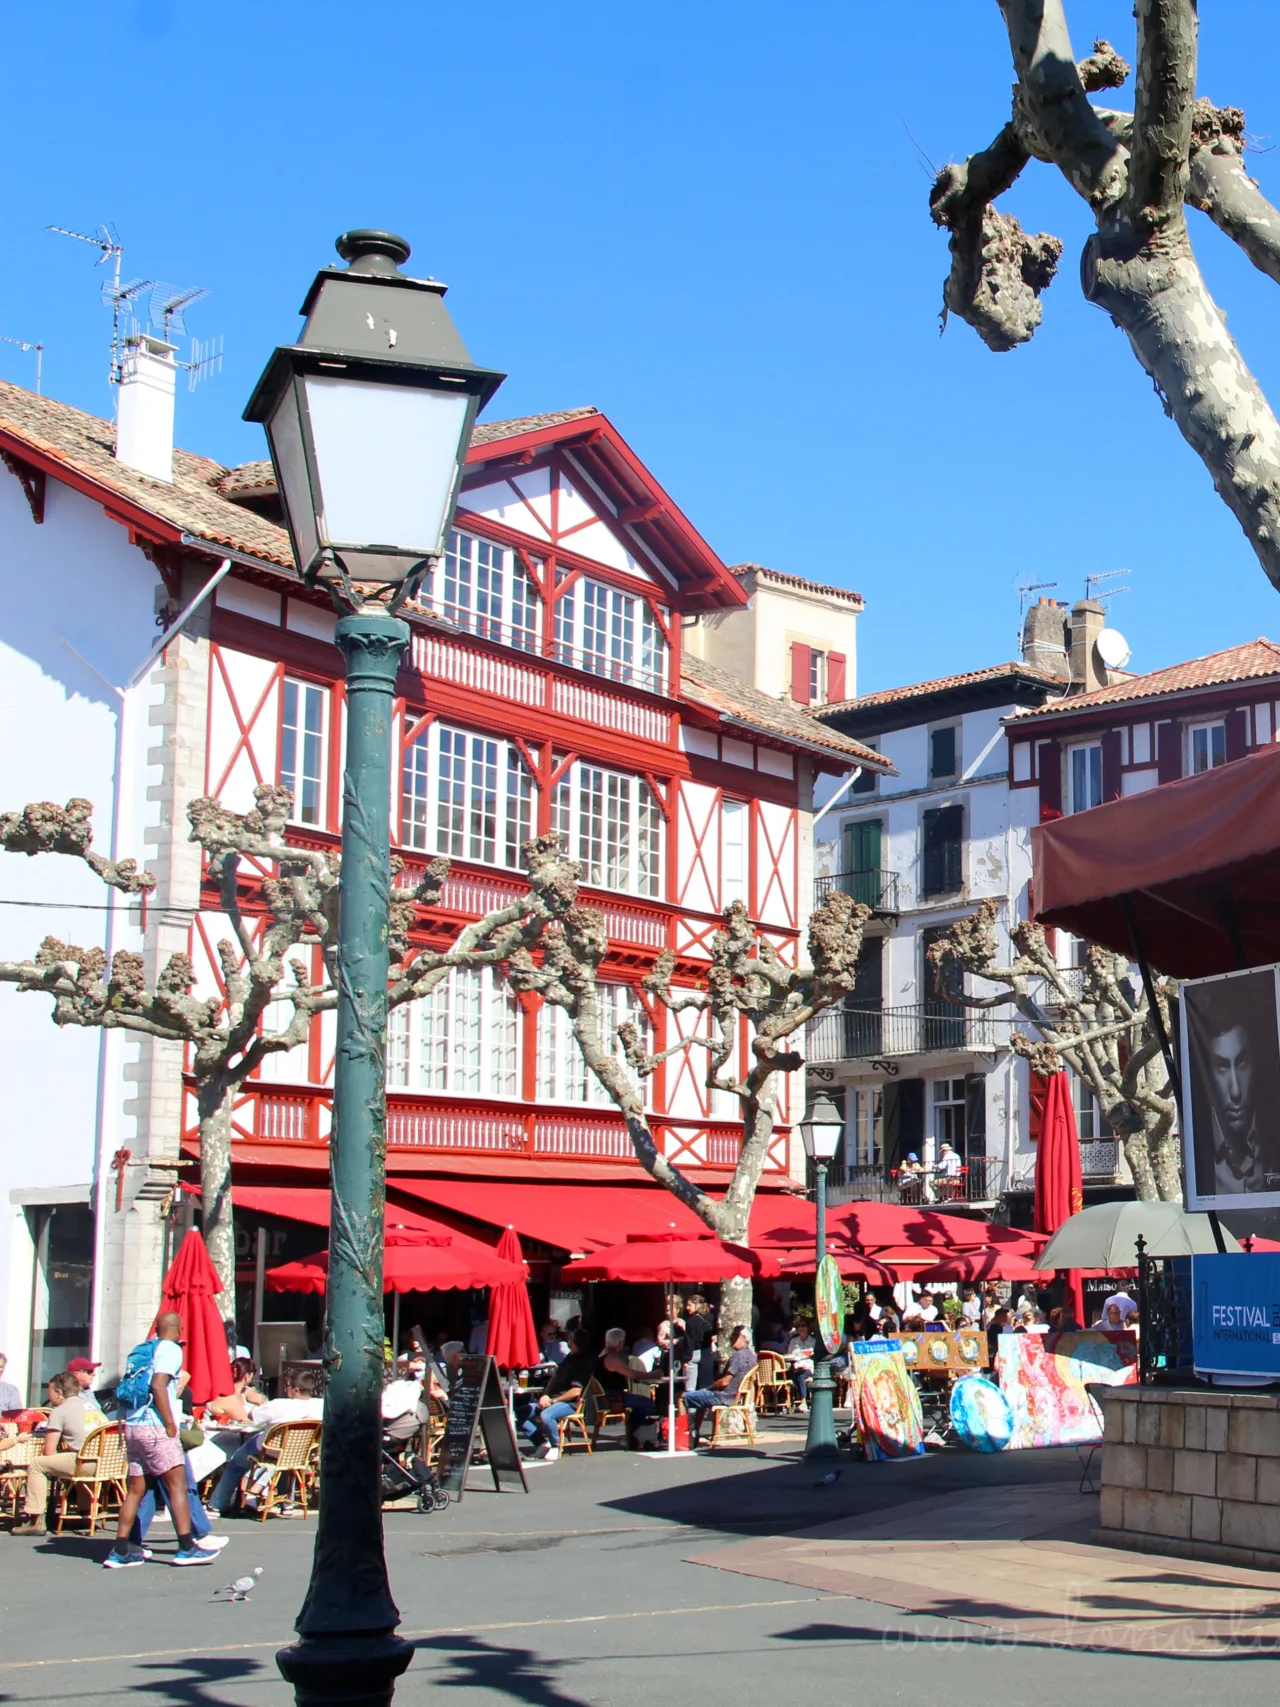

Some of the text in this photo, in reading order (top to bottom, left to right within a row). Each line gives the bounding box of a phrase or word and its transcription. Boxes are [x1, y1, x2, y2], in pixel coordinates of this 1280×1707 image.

[1086, 1279, 1117, 1292] Maiso
[1212, 1305, 1270, 1327] FESTIVAL
[1272, 1303, 1280, 1327] DU
[1213, 1329, 1270, 1342] INTERNATIONAL
